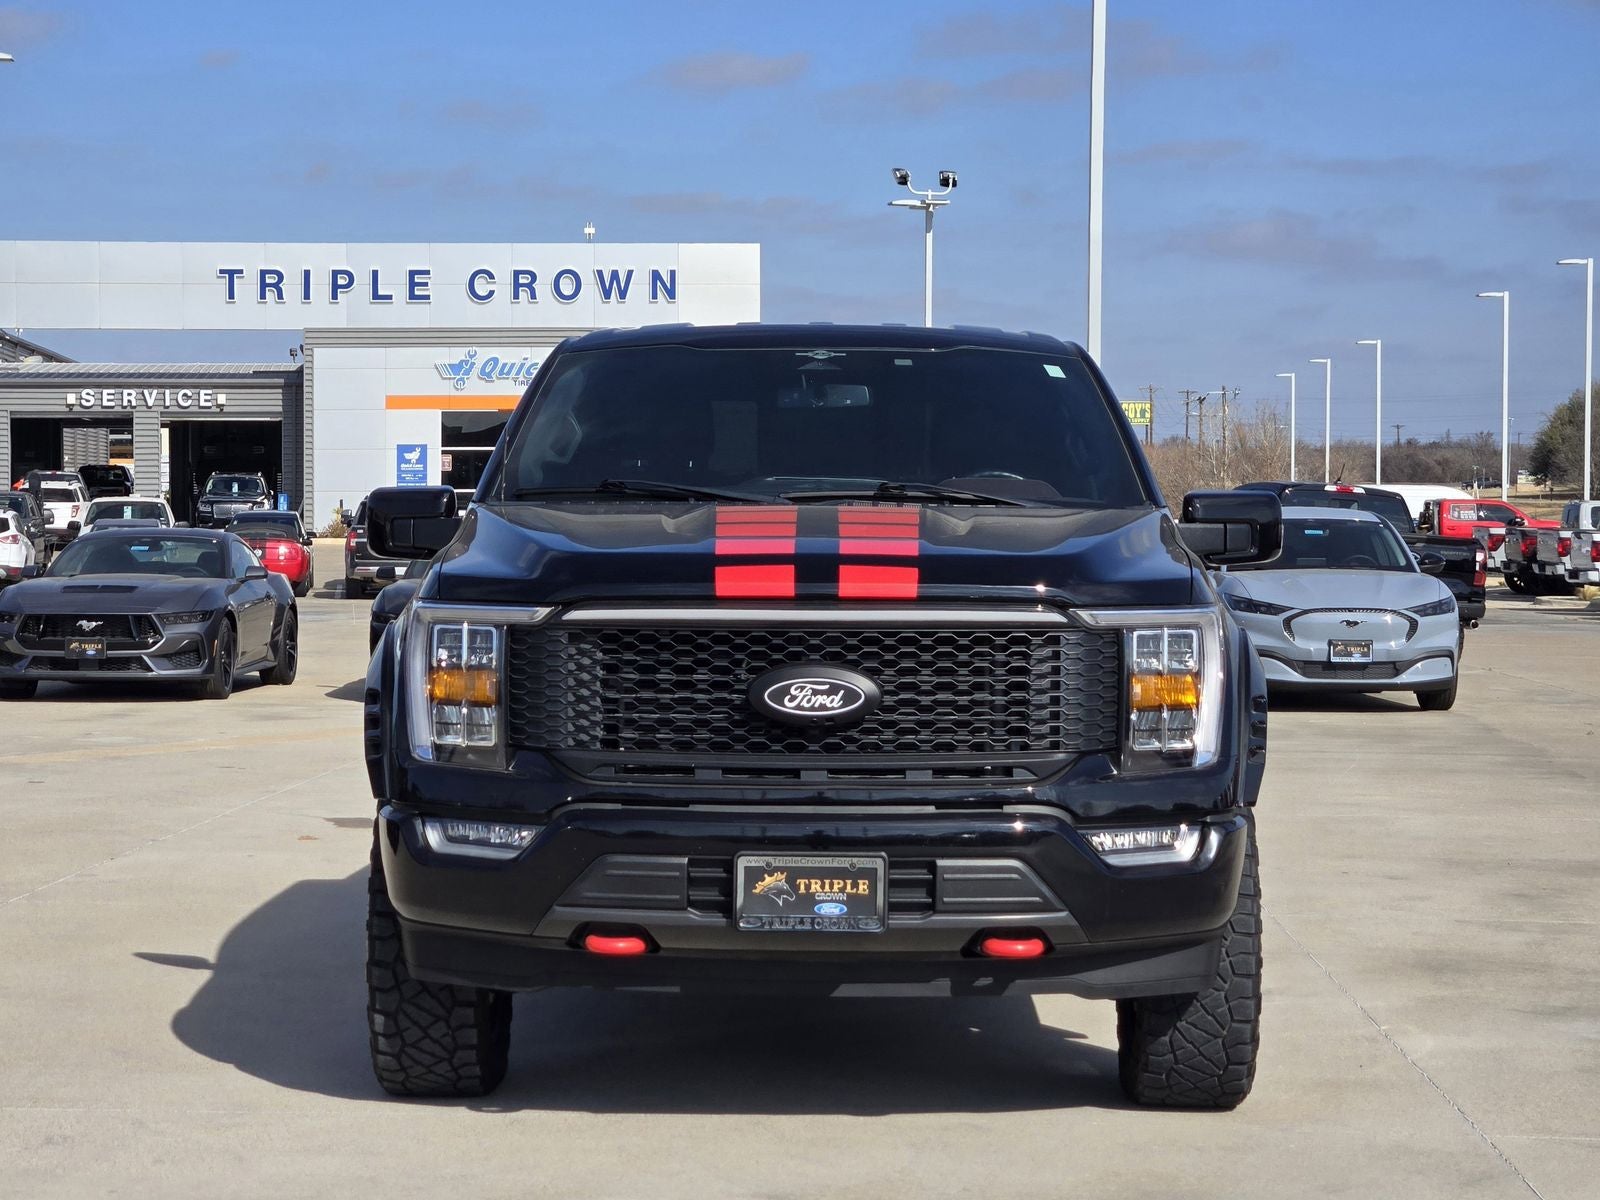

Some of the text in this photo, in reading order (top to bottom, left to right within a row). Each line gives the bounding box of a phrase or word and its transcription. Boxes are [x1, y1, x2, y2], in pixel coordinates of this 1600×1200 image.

[217, 268, 678, 303] TRIPLE CROWN
[479, 357, 540, 381] Quic
[80, 389, 214, 408] SERVICE
[784, 683, 844, 708] Ford
[746, 857, 877, 866] wwwTripleCrownFordcom
[796, 878, 869, 895] TRIPLE
[815, 892, 847, 901] CROWN
[762, 917, 812, 929] TRIPLE
[814, 917, 858, 930] CROWN
